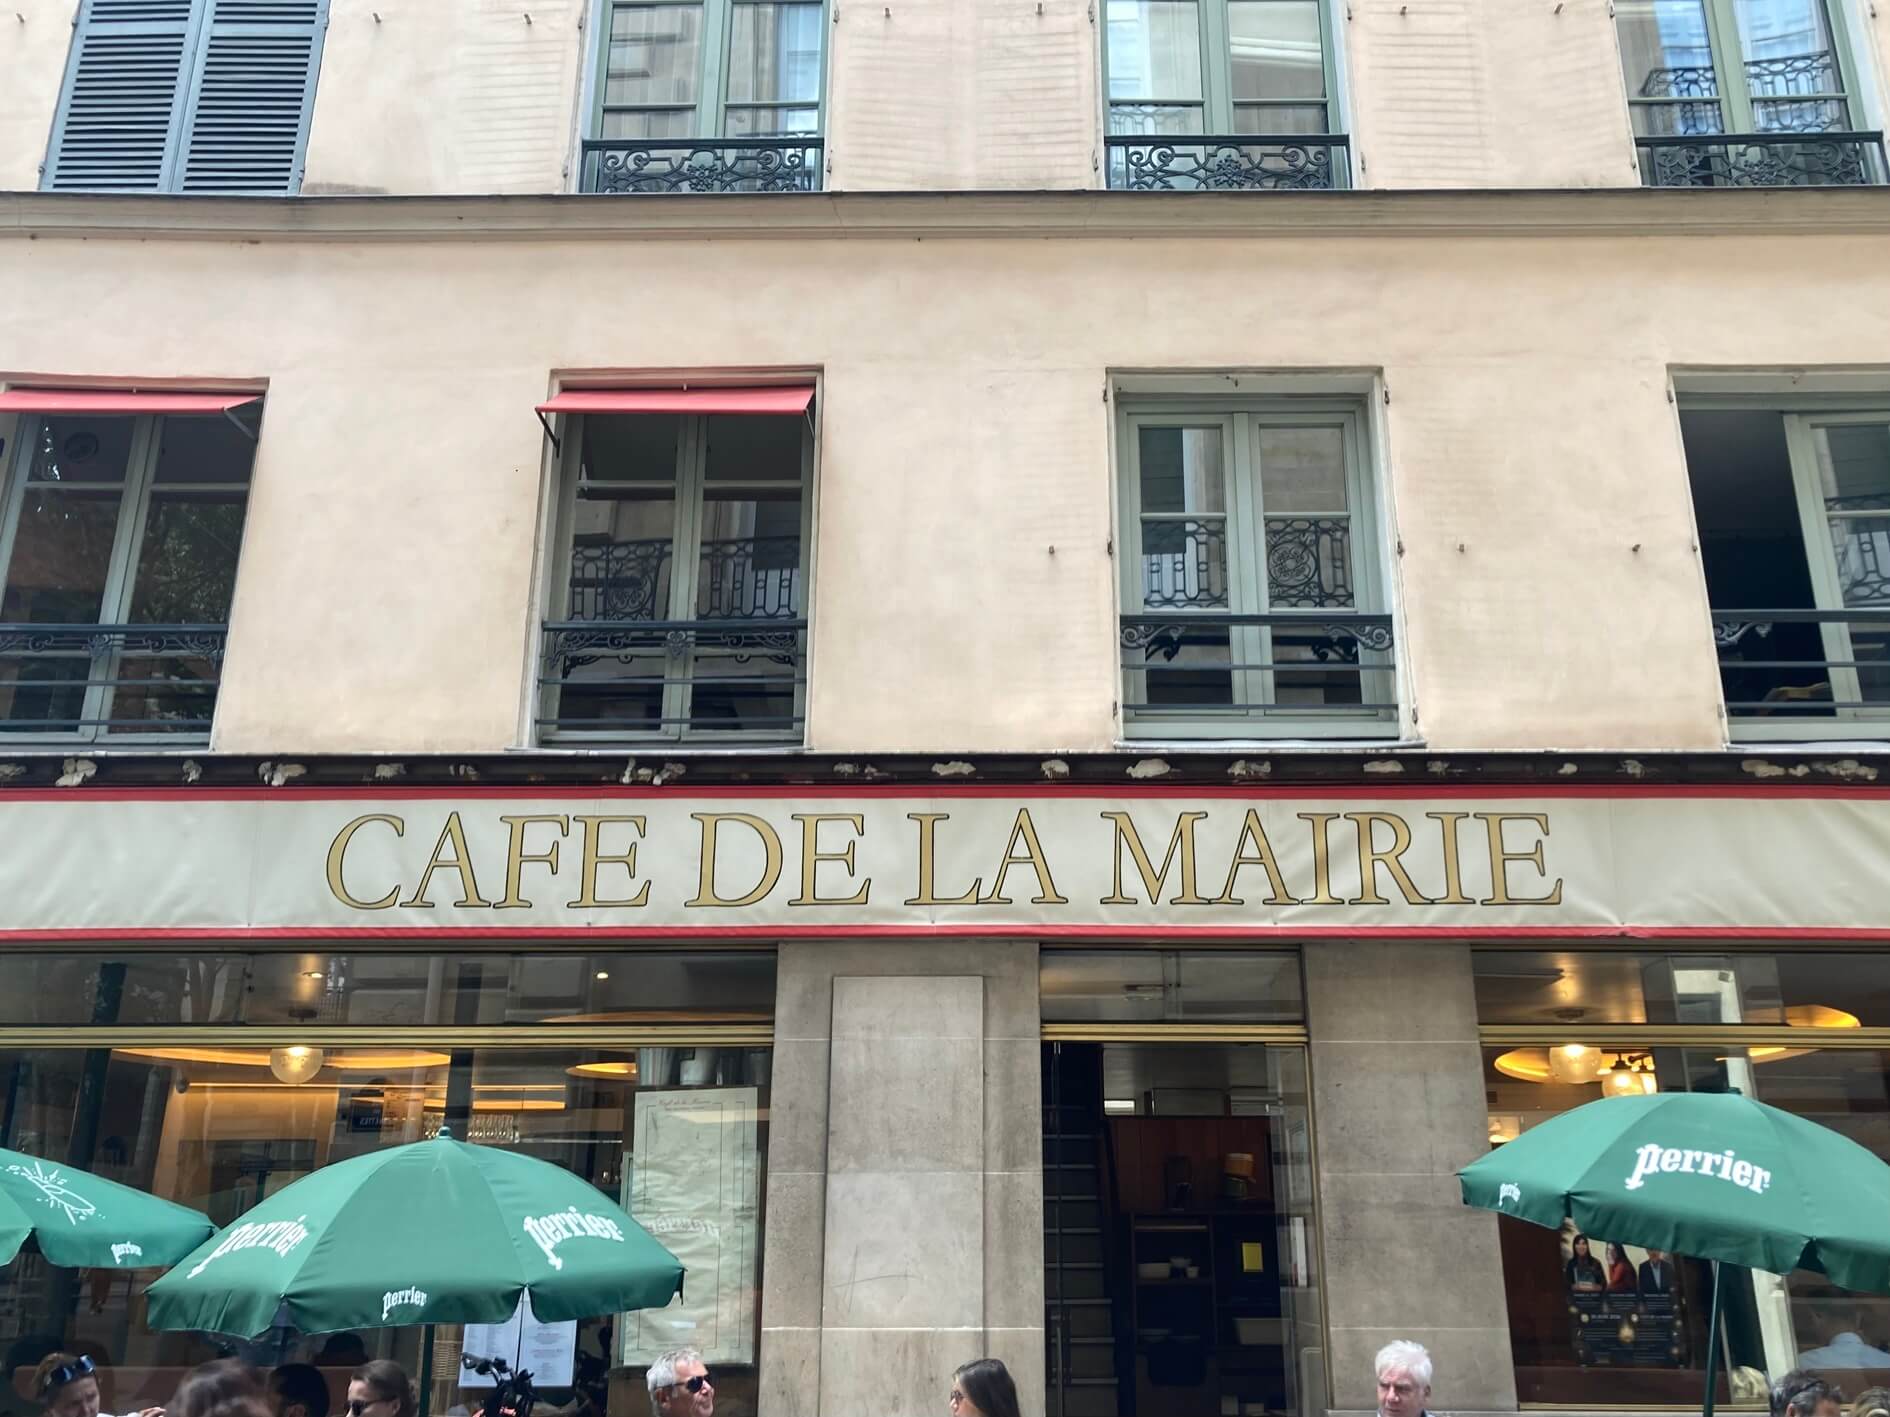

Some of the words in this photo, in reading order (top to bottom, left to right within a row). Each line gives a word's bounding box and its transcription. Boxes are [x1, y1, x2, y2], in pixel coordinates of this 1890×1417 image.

[326, 811, 652, 910] CAFE
[683, 812, 872, 908] DE
[903, 807, 1069, 906] LA
[1099, 807, 1564, 907] MAIRIE
